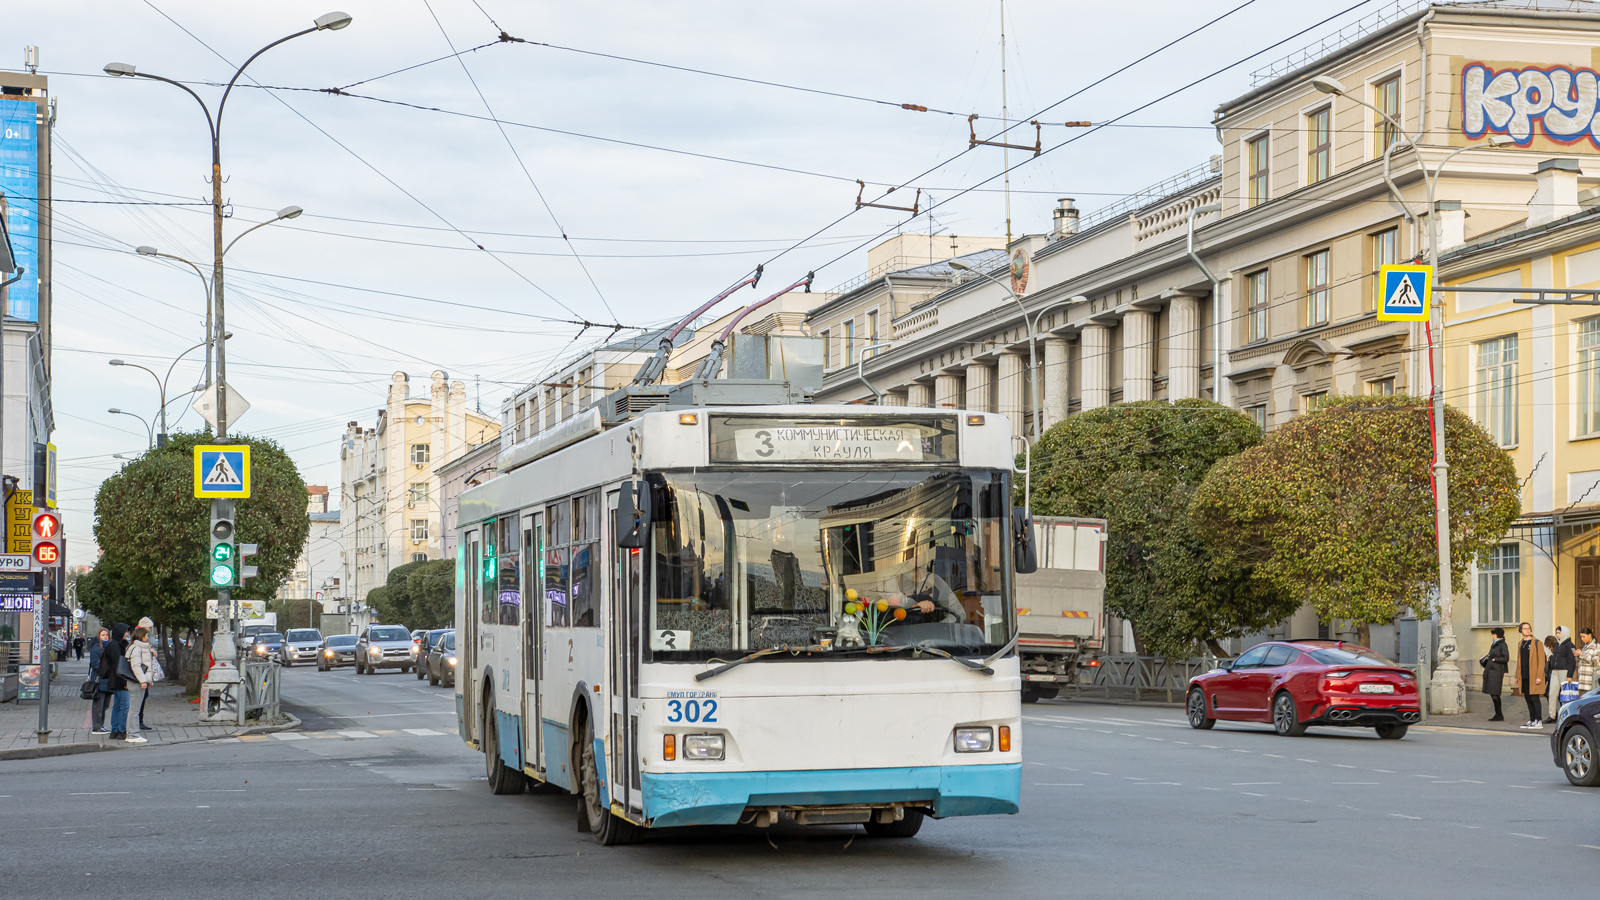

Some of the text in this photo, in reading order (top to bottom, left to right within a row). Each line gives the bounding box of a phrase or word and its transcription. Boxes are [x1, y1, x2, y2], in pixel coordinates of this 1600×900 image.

[5, 128, 20, 139] 0+
[1090, 284, 1139, 314] БАНК
[754, 429, 904, 458] 3 КОММУНИСТИЧЕСКАЯ
[813, 445, 872, 459] КРАУЛЯ
[13, 491, 32, 552] КУПЕ
[39, 546, 57, 561] 66
[215, 546, 230, 559] 24
[33, 609, 41, 651] КАЛЬЯНЫ
[667, 699, 718, 723] 302
